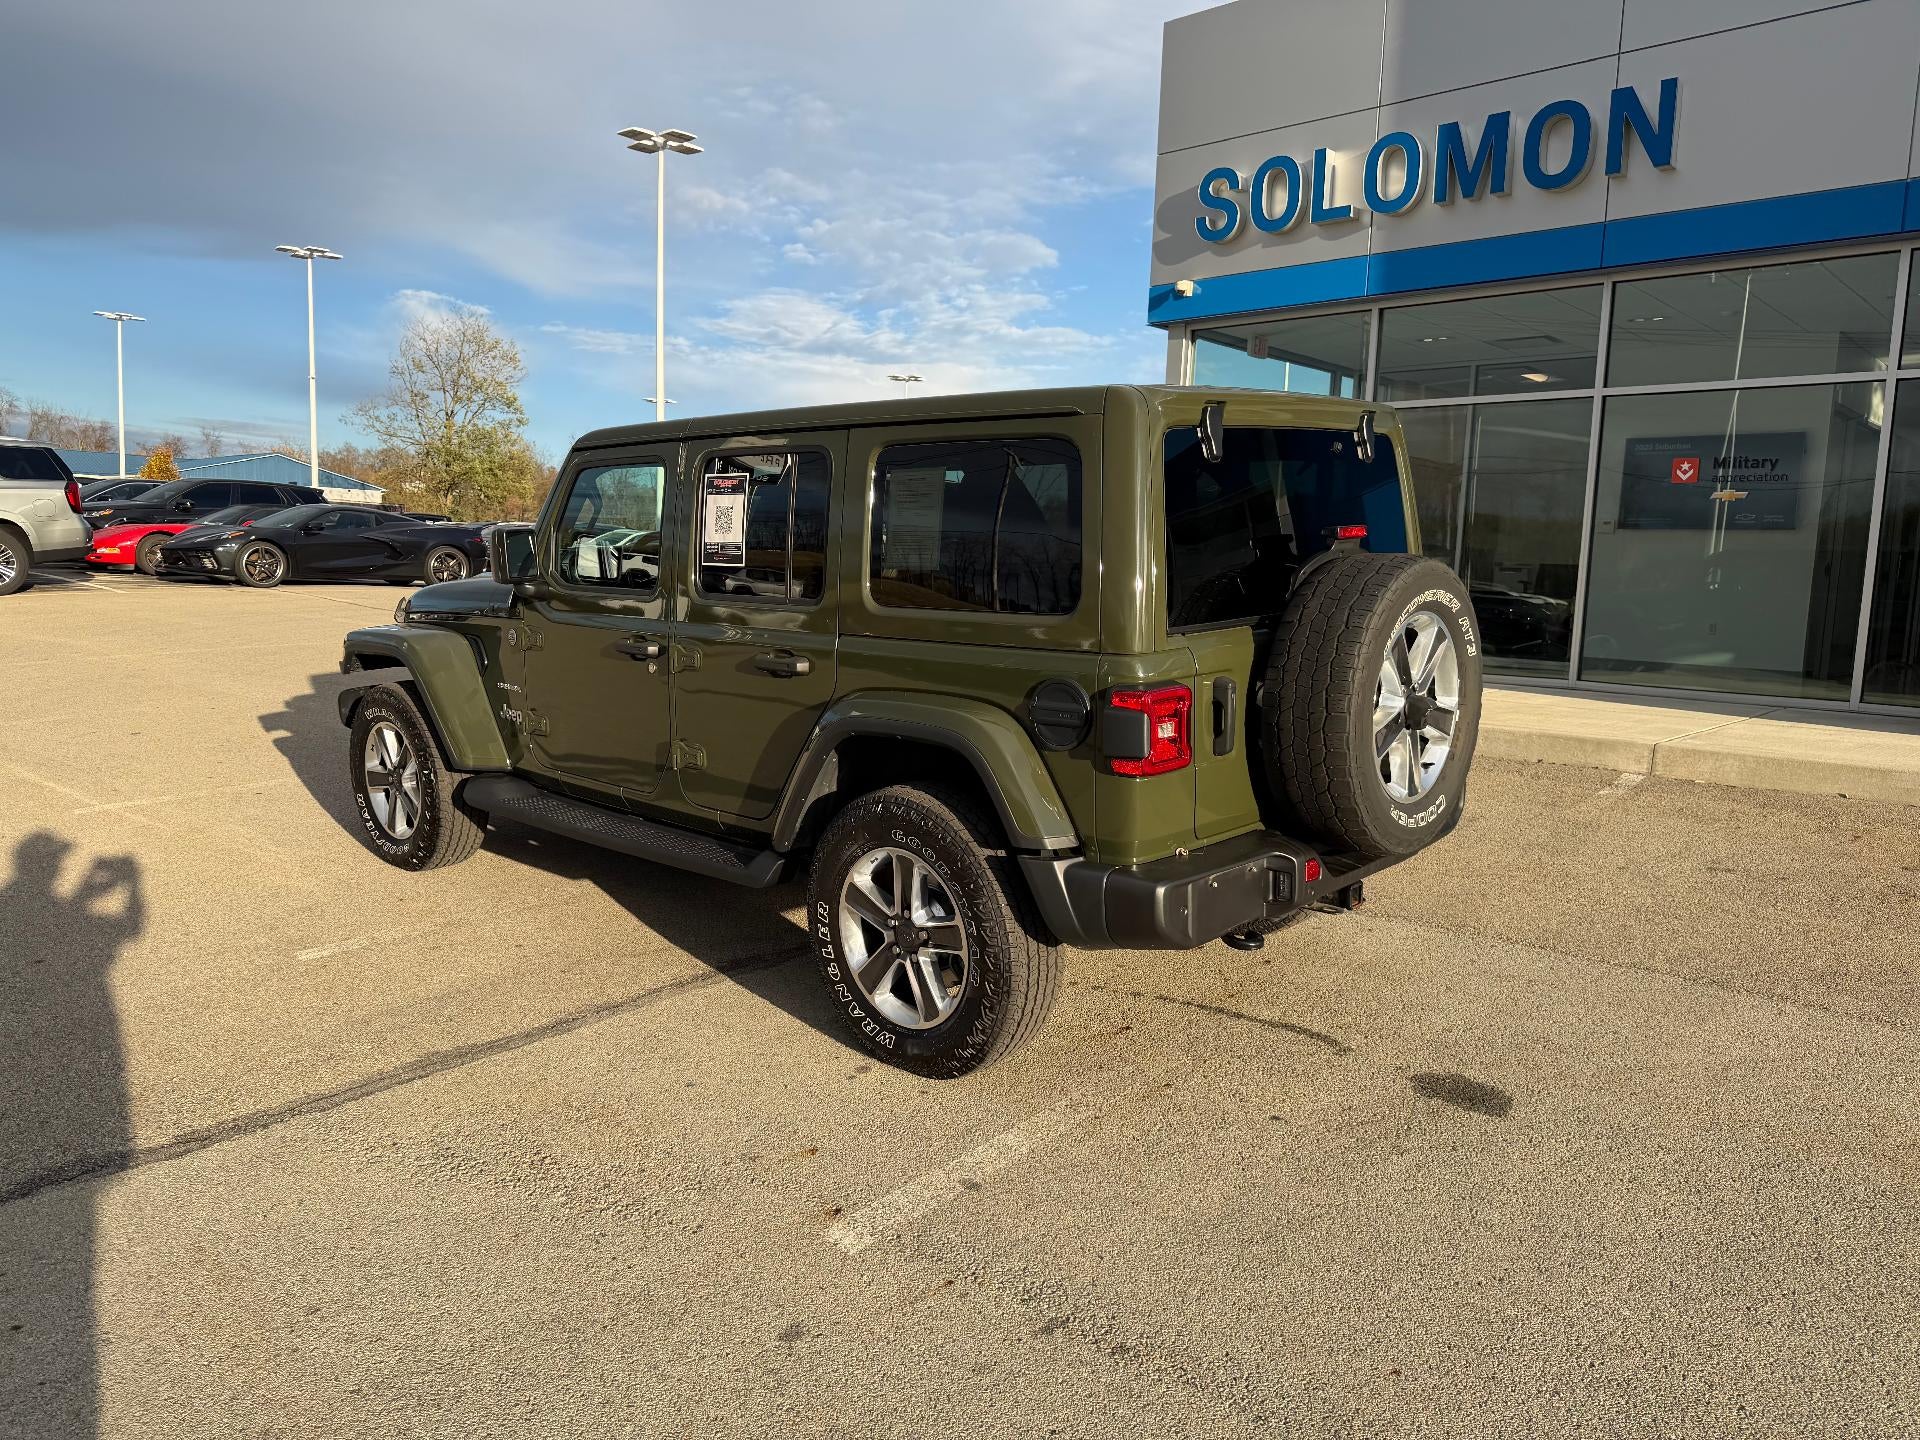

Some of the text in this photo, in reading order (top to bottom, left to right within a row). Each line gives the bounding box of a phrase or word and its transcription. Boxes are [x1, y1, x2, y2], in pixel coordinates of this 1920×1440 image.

[1194, 77, 1681, 243] SOLOMON
[1655, 442, 1692, 450] Suburban
[1713, 455, 1779, 471] Military
[1712, 473, 1788, 484] appreciation
[500, 703, 522, 725] Jeep
[1390, 794, 1446, 828] COOPER
[817, 901, 895, 1049] WRANGLER
